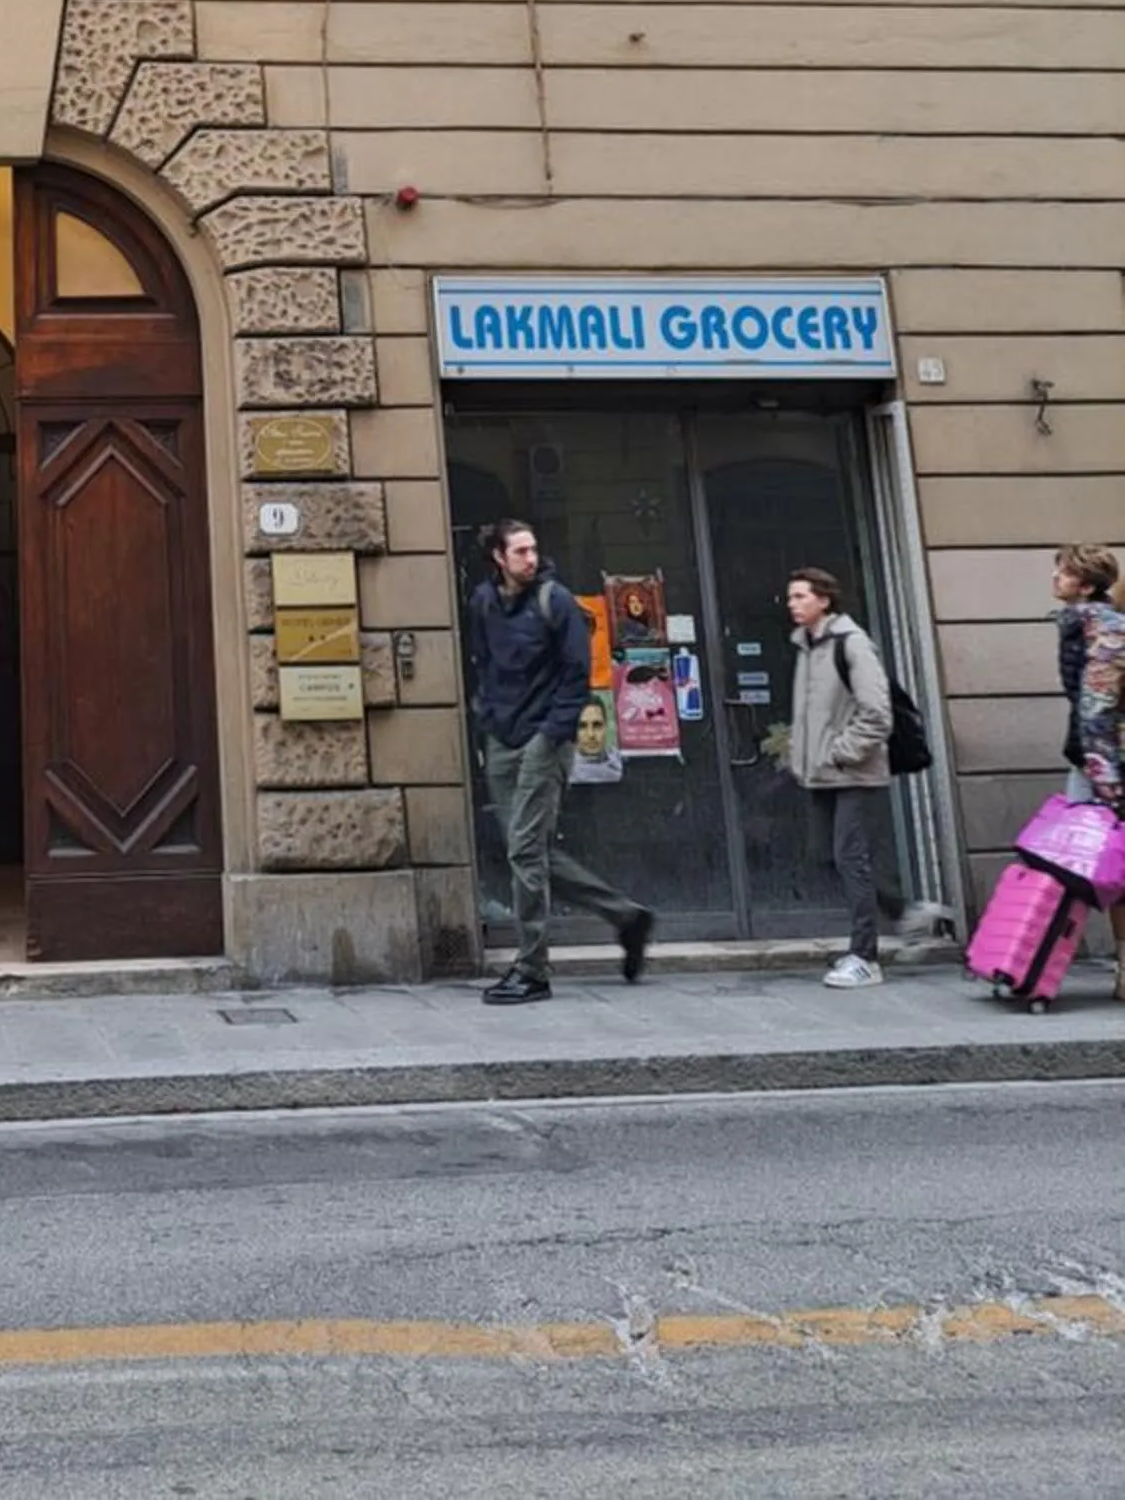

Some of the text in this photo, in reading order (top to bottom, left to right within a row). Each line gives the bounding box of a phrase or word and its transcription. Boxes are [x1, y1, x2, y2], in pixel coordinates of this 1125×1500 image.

[449, 305, 879, 350] LAKMALI GROCERY
[271, 506, 285, 529] 9
